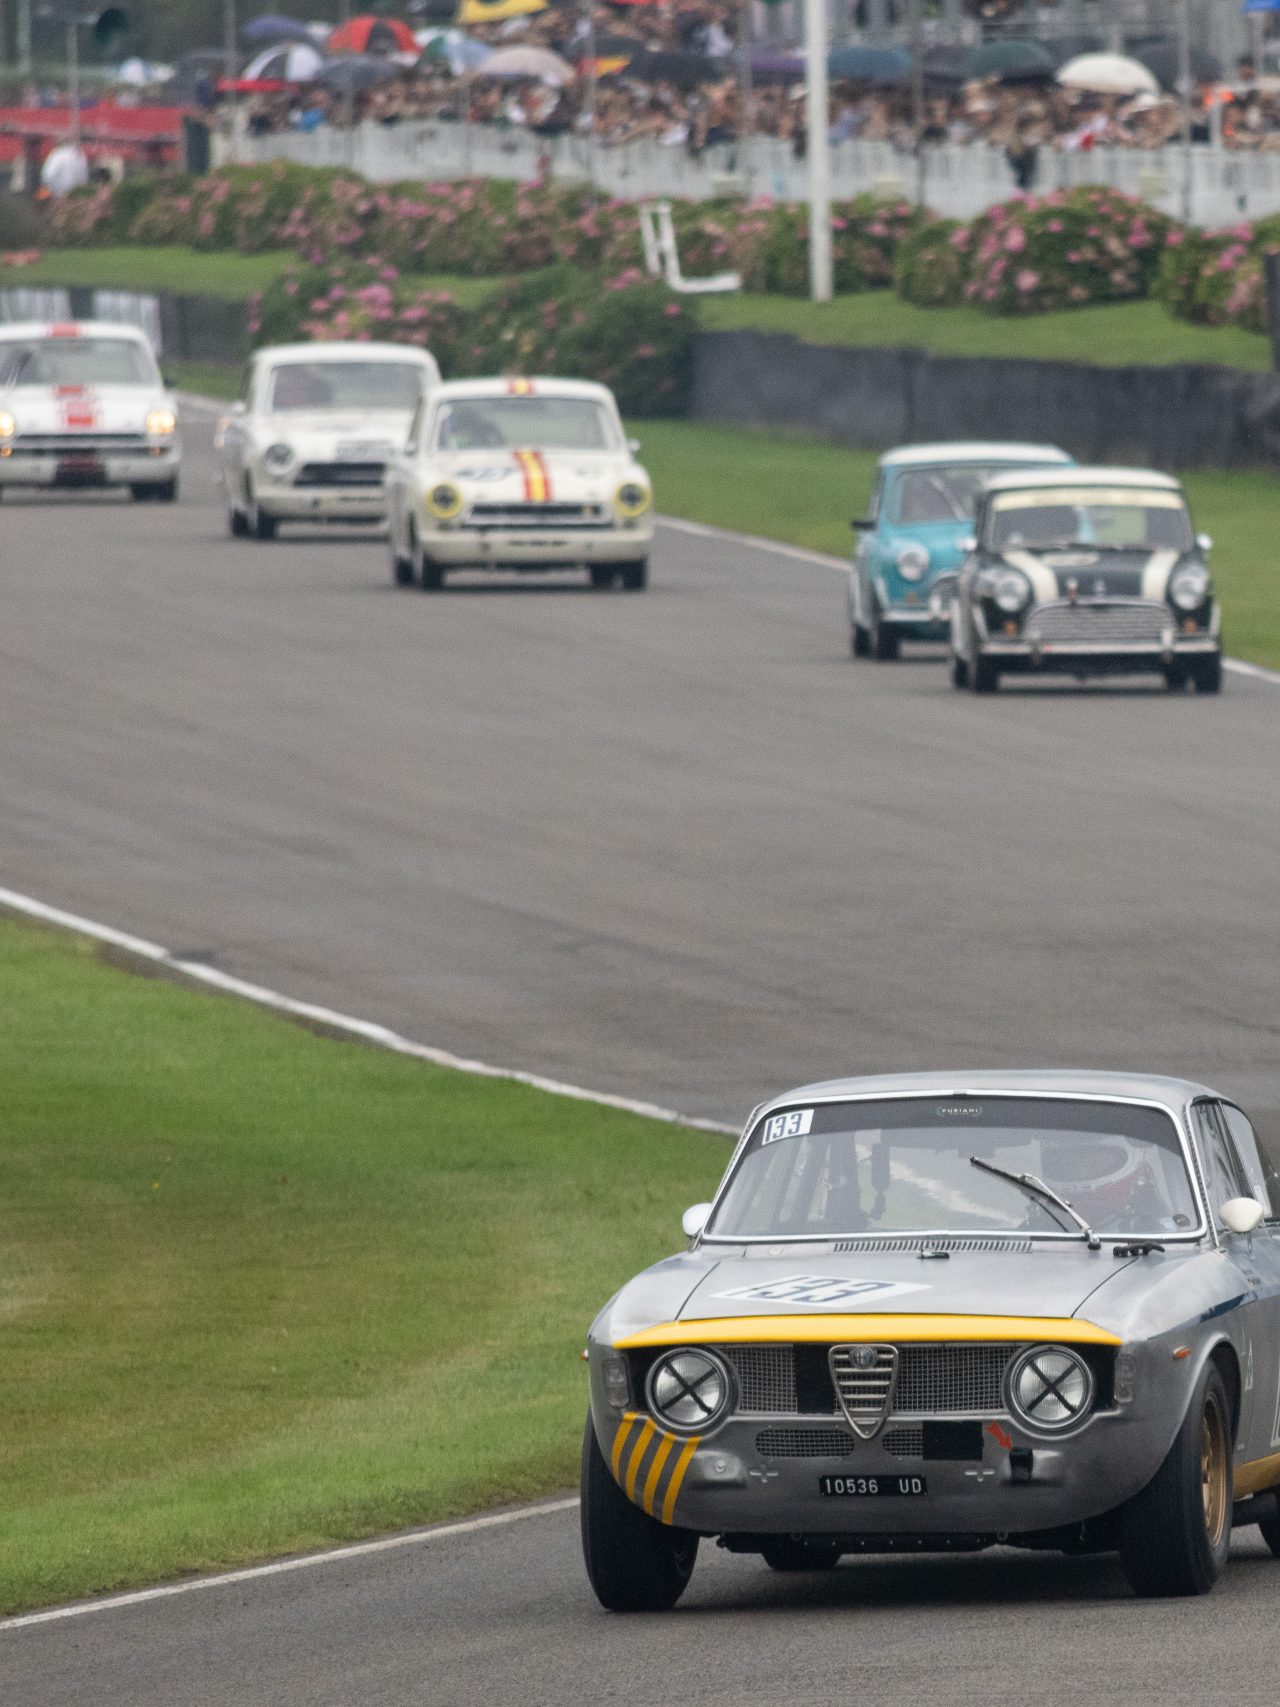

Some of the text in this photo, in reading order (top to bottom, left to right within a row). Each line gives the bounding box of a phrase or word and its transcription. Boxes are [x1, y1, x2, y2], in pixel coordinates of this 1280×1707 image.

[764, 1112, 804, 1143] 133
[725, 1276, 897, 1303] 133
[825, 1478, 922, 1494] 10536 UD
